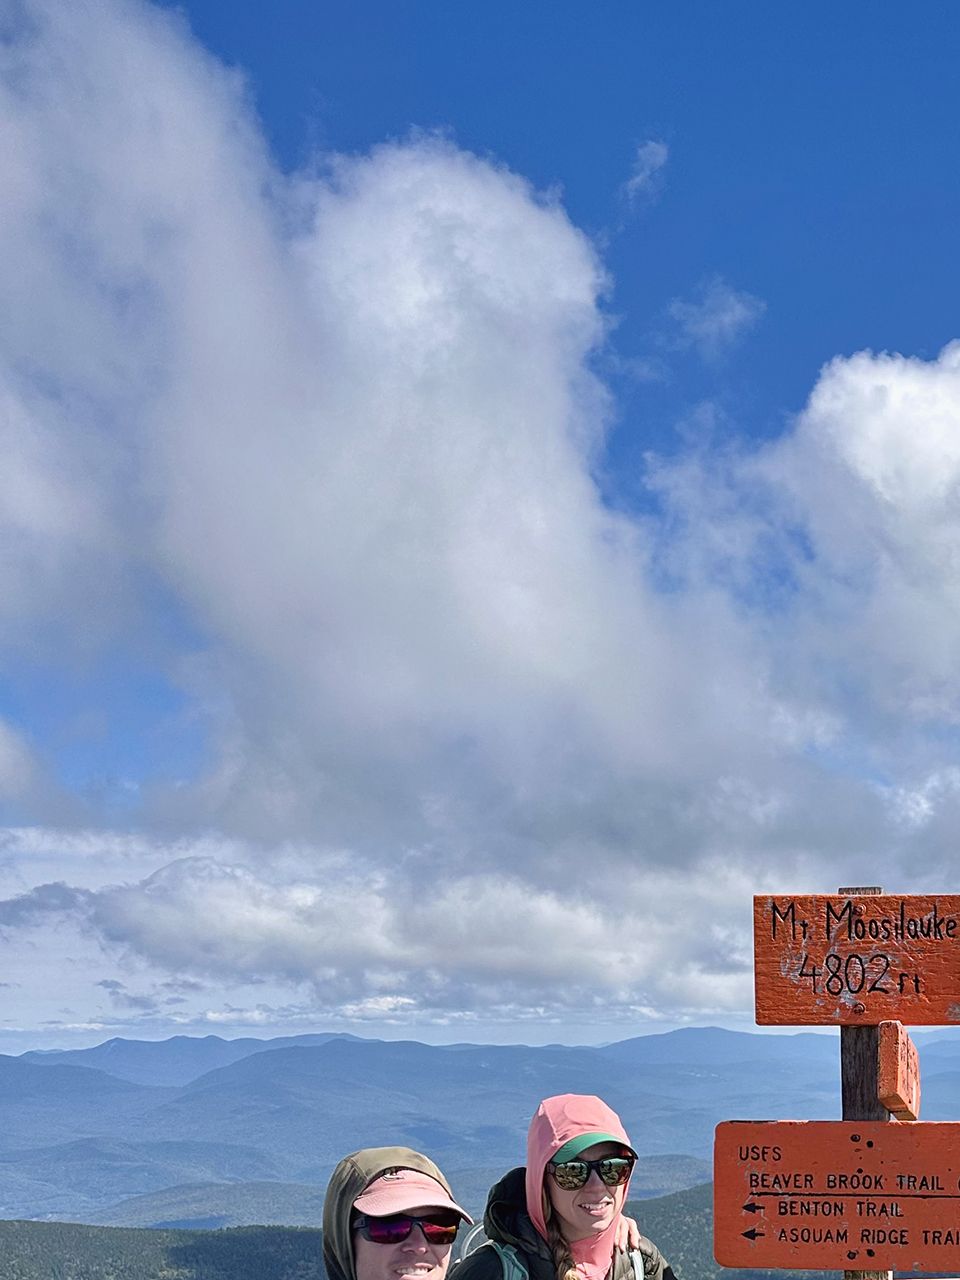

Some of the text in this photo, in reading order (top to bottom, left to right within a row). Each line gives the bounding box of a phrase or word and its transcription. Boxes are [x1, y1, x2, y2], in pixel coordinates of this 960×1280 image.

[825, 900, 958, 941] Moosilauke
[798, 953, 890, 996] 4802
[738, 1145, 782, 1162] USFS
[749, 1173, 814, 1190] BEAVER
[827, 1174, 884, 1190] BROOK
[897, 1174, 945, 1191] TRAIL
[778, 1201, 844, 1217] BENTON
[856, 1201, 904, 1218] TRAIL
[860, 1229, 909, 1245] RIDGE
